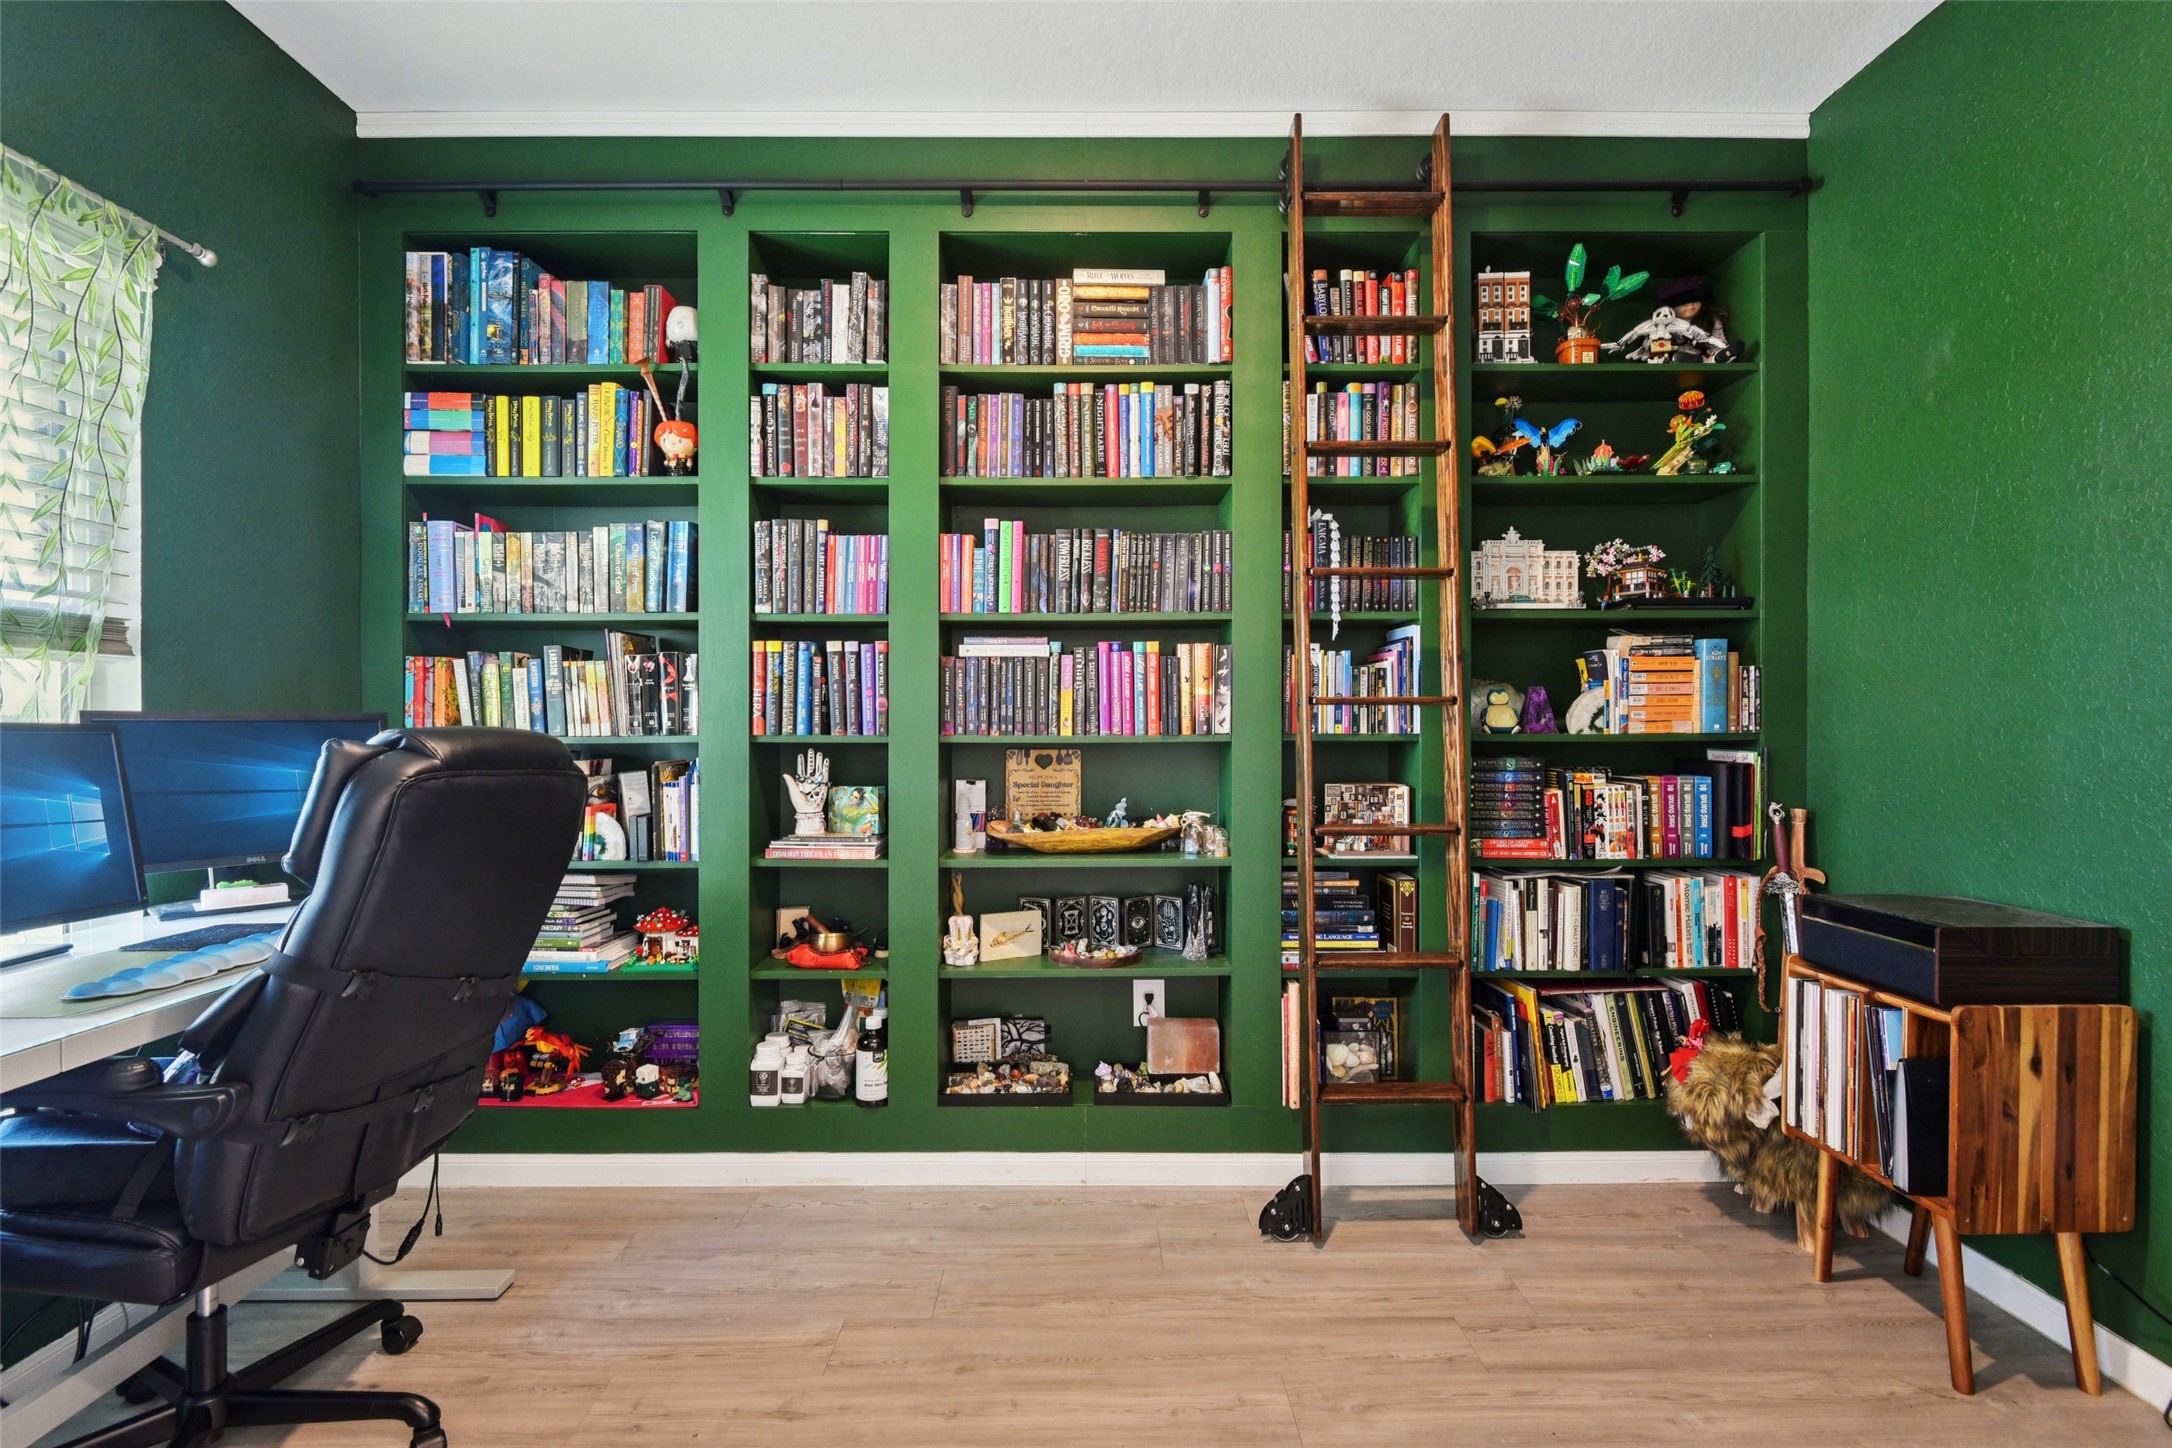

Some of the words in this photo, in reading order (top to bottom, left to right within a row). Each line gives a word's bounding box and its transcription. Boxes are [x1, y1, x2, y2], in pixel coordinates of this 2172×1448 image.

[1110, 272, 1135, 280] WOLVES
[1058, 286, 1071, 313] ORO
[1317, 522, 1327, 555] ENIGMA
[614, 543, 623, 565] Chain
[631, 544, 640, 565] Chain
[1058, 539, 1071, 581] POWERLESS
[1081, 539, 1093, 574] RECKLESS
[548, 649, 558, 676] LARSSON
[753, 688, 762, 717] HERA
[1012, 781, 1040, 790] Special
[1041, 781, 1074, 789] Daughter
[1609, 1006, 1625, 1062] ENGINEERING
